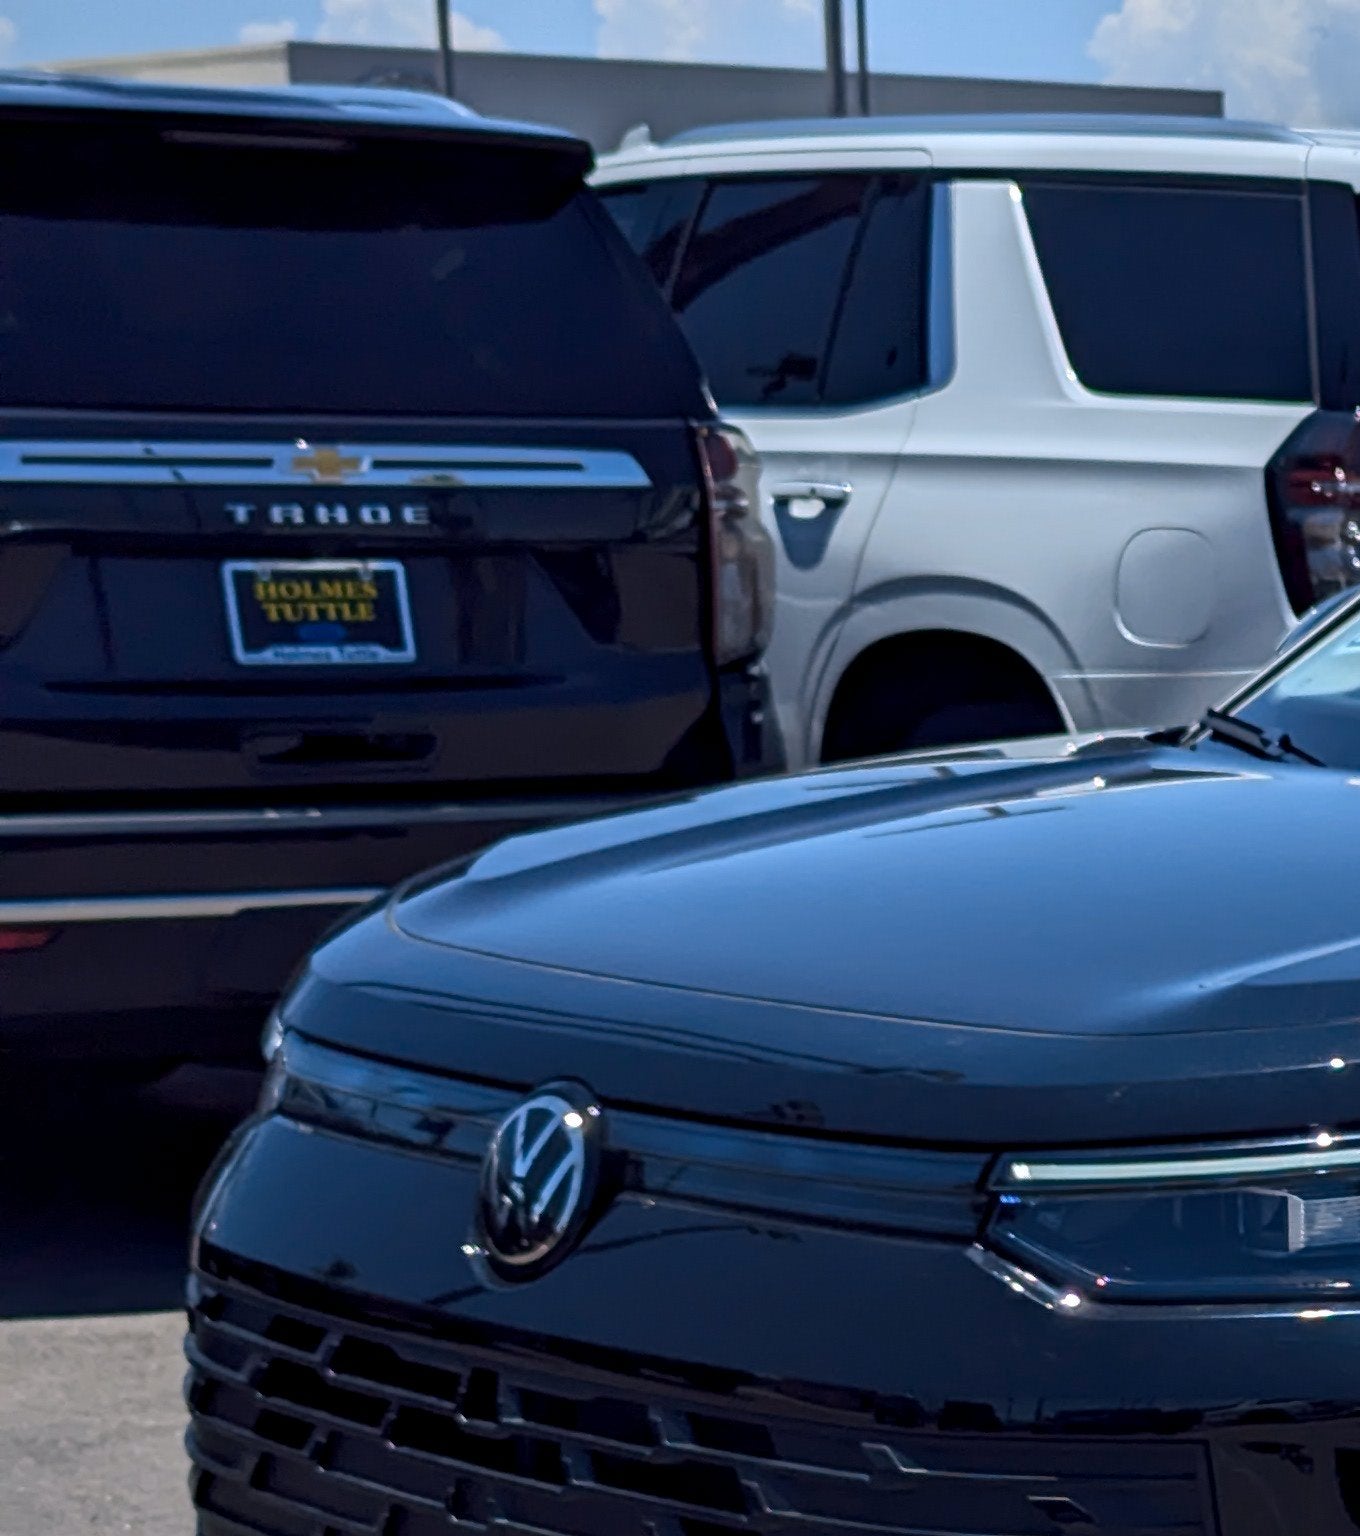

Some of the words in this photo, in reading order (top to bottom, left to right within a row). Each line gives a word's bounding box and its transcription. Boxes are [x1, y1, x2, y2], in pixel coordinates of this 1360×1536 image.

[225, 503, 430, 525] TAHOE
[255, 580, 378, 600] HOLMES
[262, 602, 376, 622] TUTTLE
